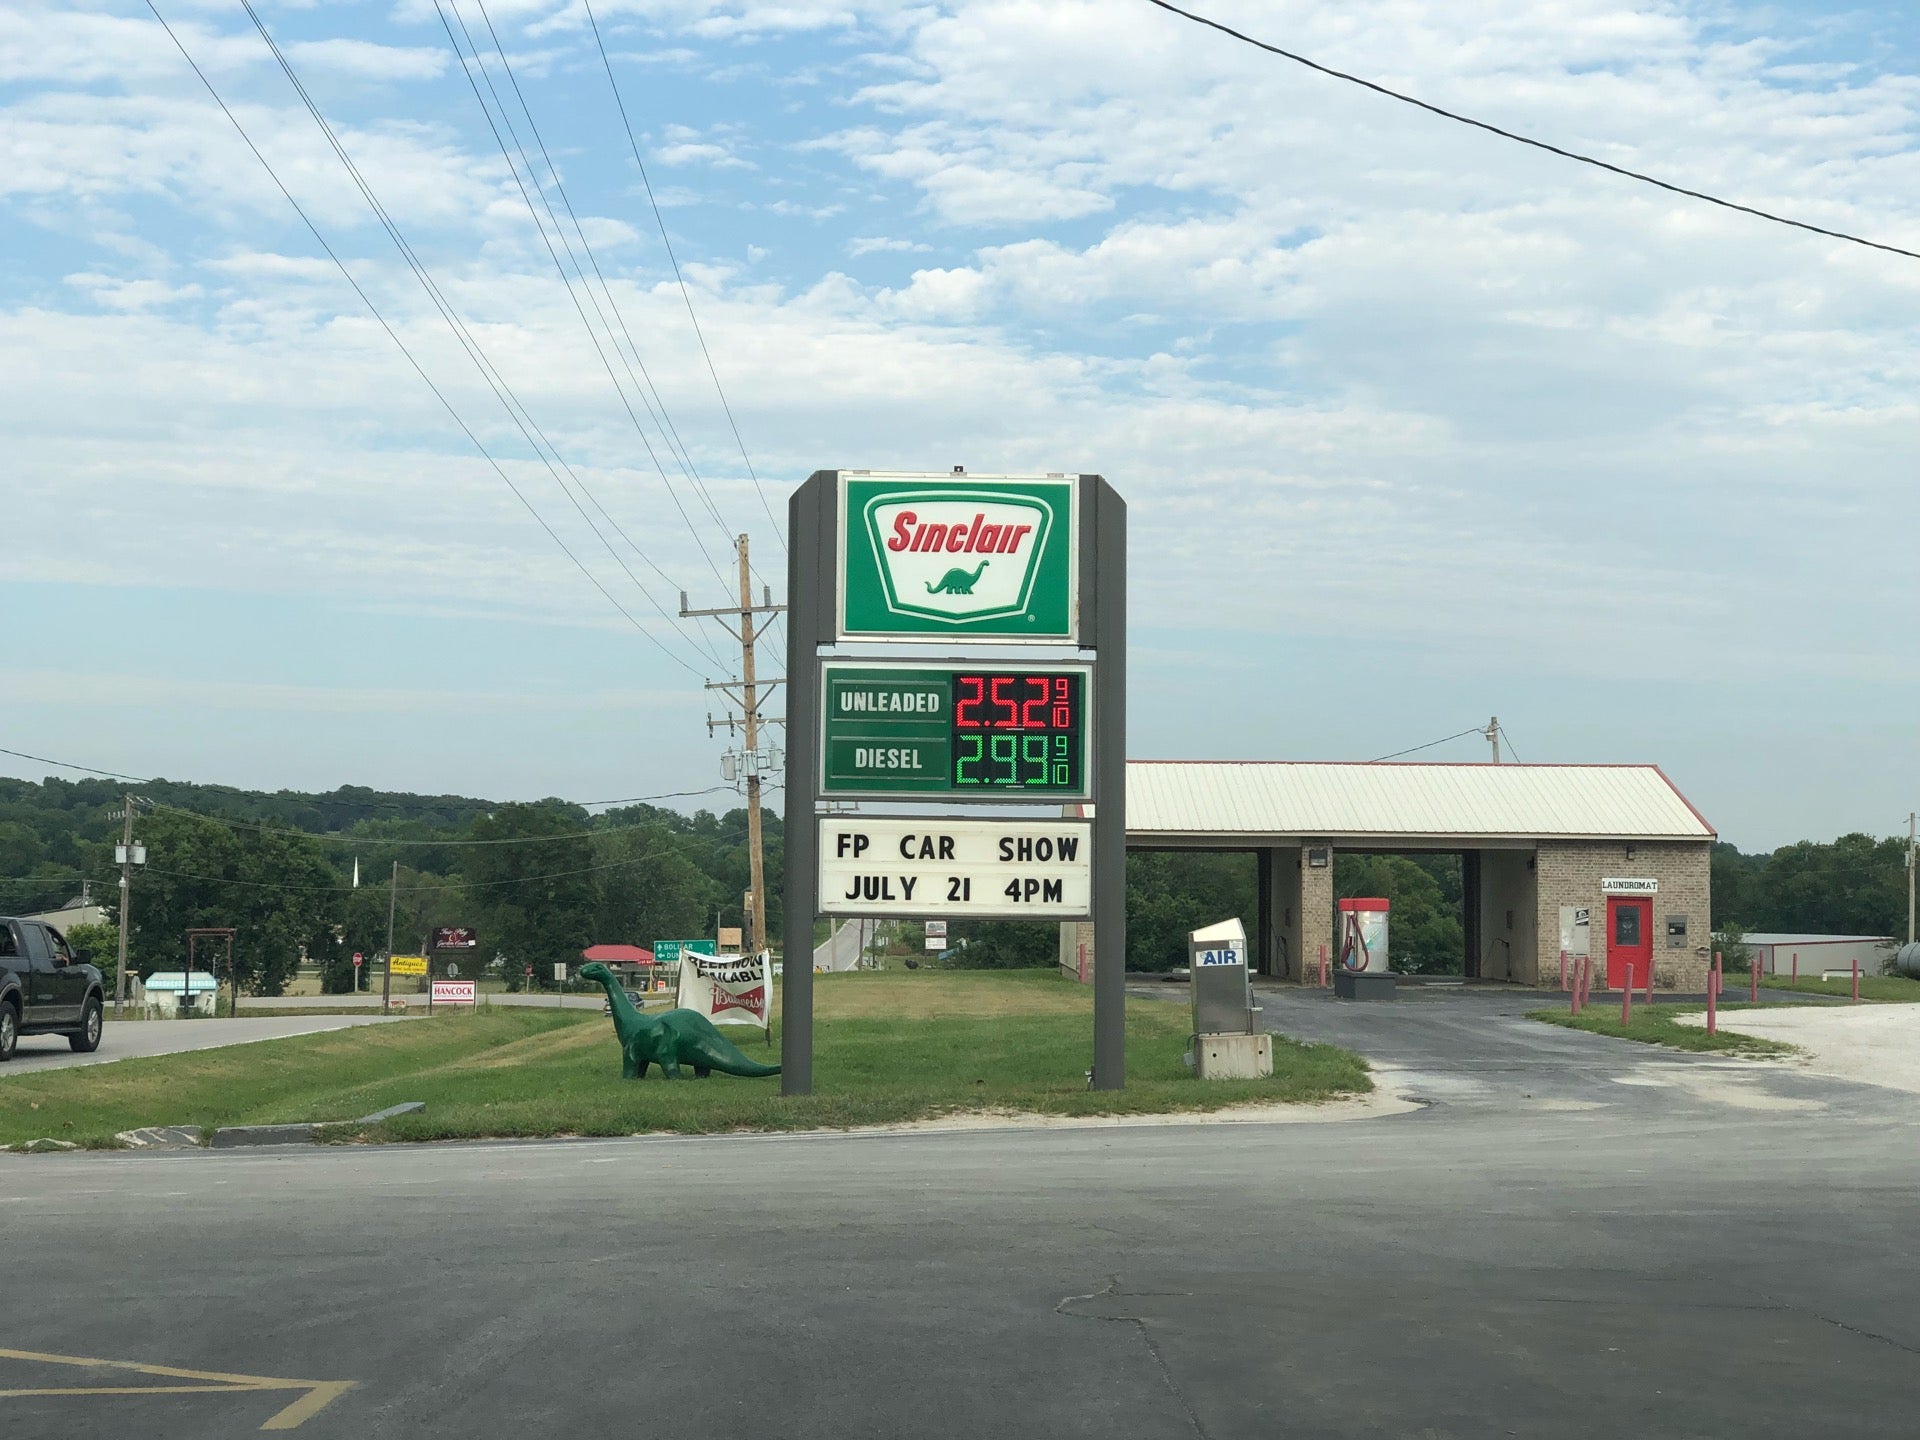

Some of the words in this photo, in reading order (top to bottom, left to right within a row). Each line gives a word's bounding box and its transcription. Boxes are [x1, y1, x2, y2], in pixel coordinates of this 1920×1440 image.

[888, 510, 1031, 554] Sinclair
[841, 691, 940, 713] UNLEADED
[957, 677, 1049, 727] 2.52
[855, 747, 923, 769] DIESEL
[957, 735, 1049, 784] 2.99
[837, 833, 870, 858] FP
[899, 835, 956, 860] CAR
[999, 837, 1079, 862] SHOW
[845, 875, 918, 901] JULY
[947, 877, 971, 902] 21
[1004, 878, 1063, 902] 4PM
[1602, 881, 1658, 890] LAUNDROMAT
[731, 954, 763, 969] NOW
[1203, 950, 1237, 965] AIR
[434, 987, 473, 995] HANCOCK
